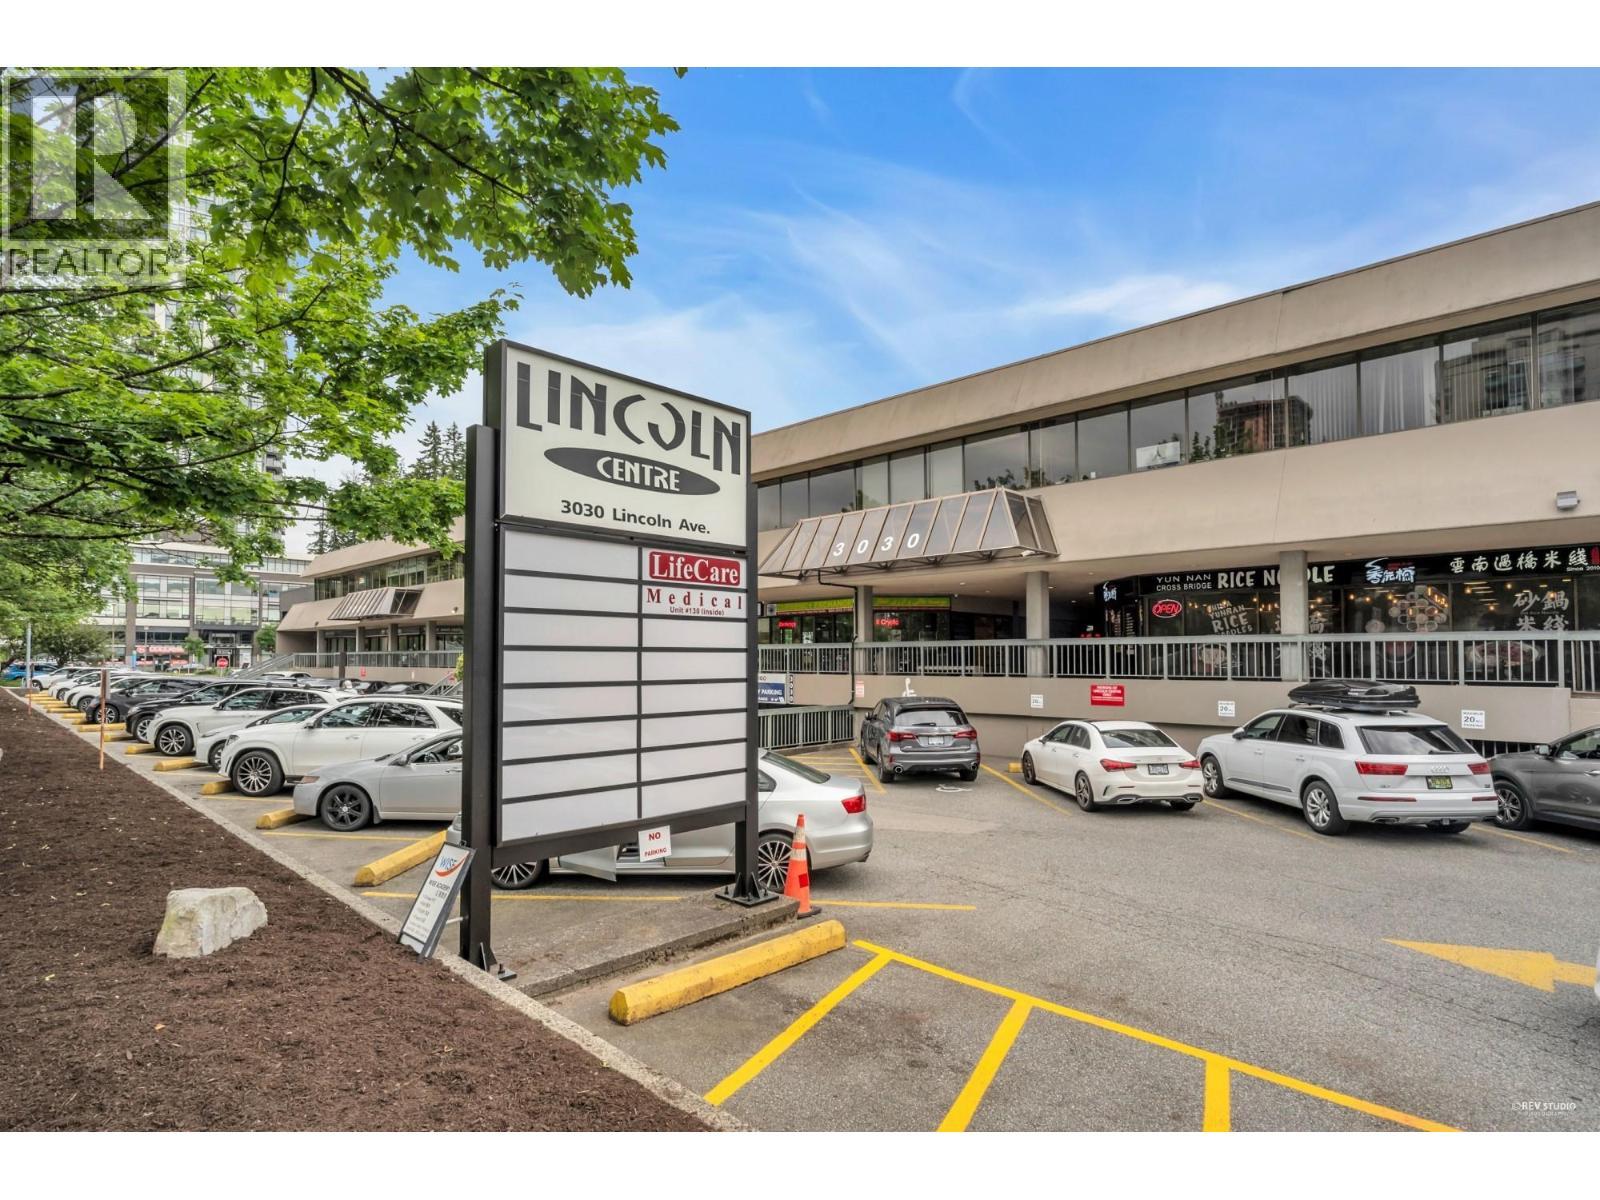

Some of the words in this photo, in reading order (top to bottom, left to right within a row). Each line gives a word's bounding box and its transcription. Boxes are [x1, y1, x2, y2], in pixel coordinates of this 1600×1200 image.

[516, 361, 741, 476] LINCOLN
[596, 456, 680, 492] CENTRE
[560, 499, 605, 519] 3030
[612, 507, 672, 529] Lincoln
[678, 519, 711, 534] Ave.
[832, 533, 920, 557] 3030
[652, 554, 739, 584] LifeCare
[1156, 575, 1180, 584] YUN
[1186, 573, 1211, 582] NAN
[1156, 583, 1181, 592] CROSS
[1183, 581, 1213, 591] BRIDGE
[1217, 570, 1256, 589] RICE
[646, 588, 742, 609] Medical
[1154, 602, 1180, 615] OPEN
[669, 606, 684, 614] Unit
[701, 608, 725, 616] (inside)
[1211, 611, 1249, 633] RICE
[648, 831, 661, 841] NO
[644, 847, 667, 857] PARKING
